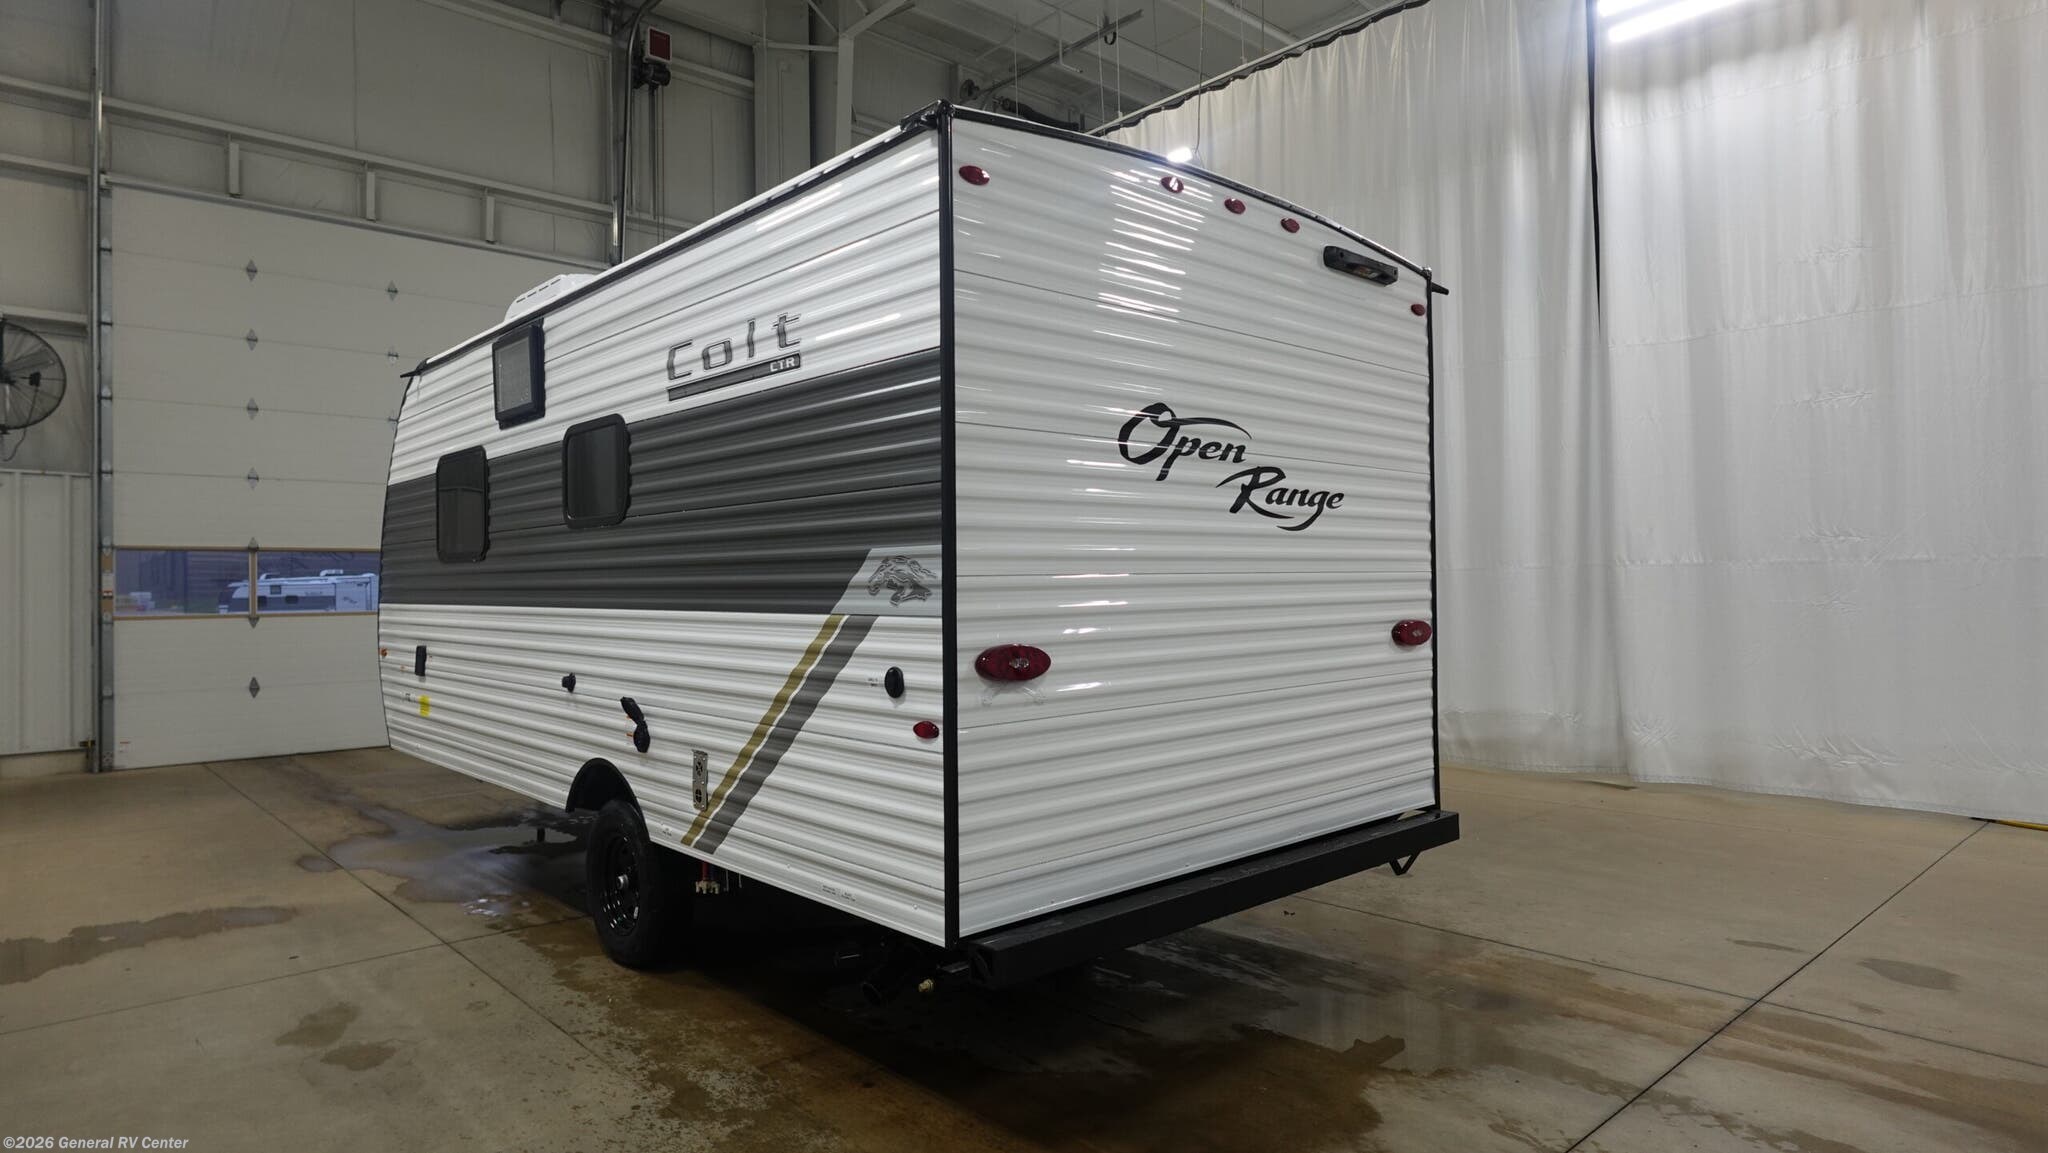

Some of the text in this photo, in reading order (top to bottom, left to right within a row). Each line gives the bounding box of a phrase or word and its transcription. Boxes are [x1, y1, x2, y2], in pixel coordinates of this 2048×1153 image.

[667, 313, 801, 381] Colt
[1118, 402, 1252, 481] Open
[1216, 466, 1345, 531] Range
